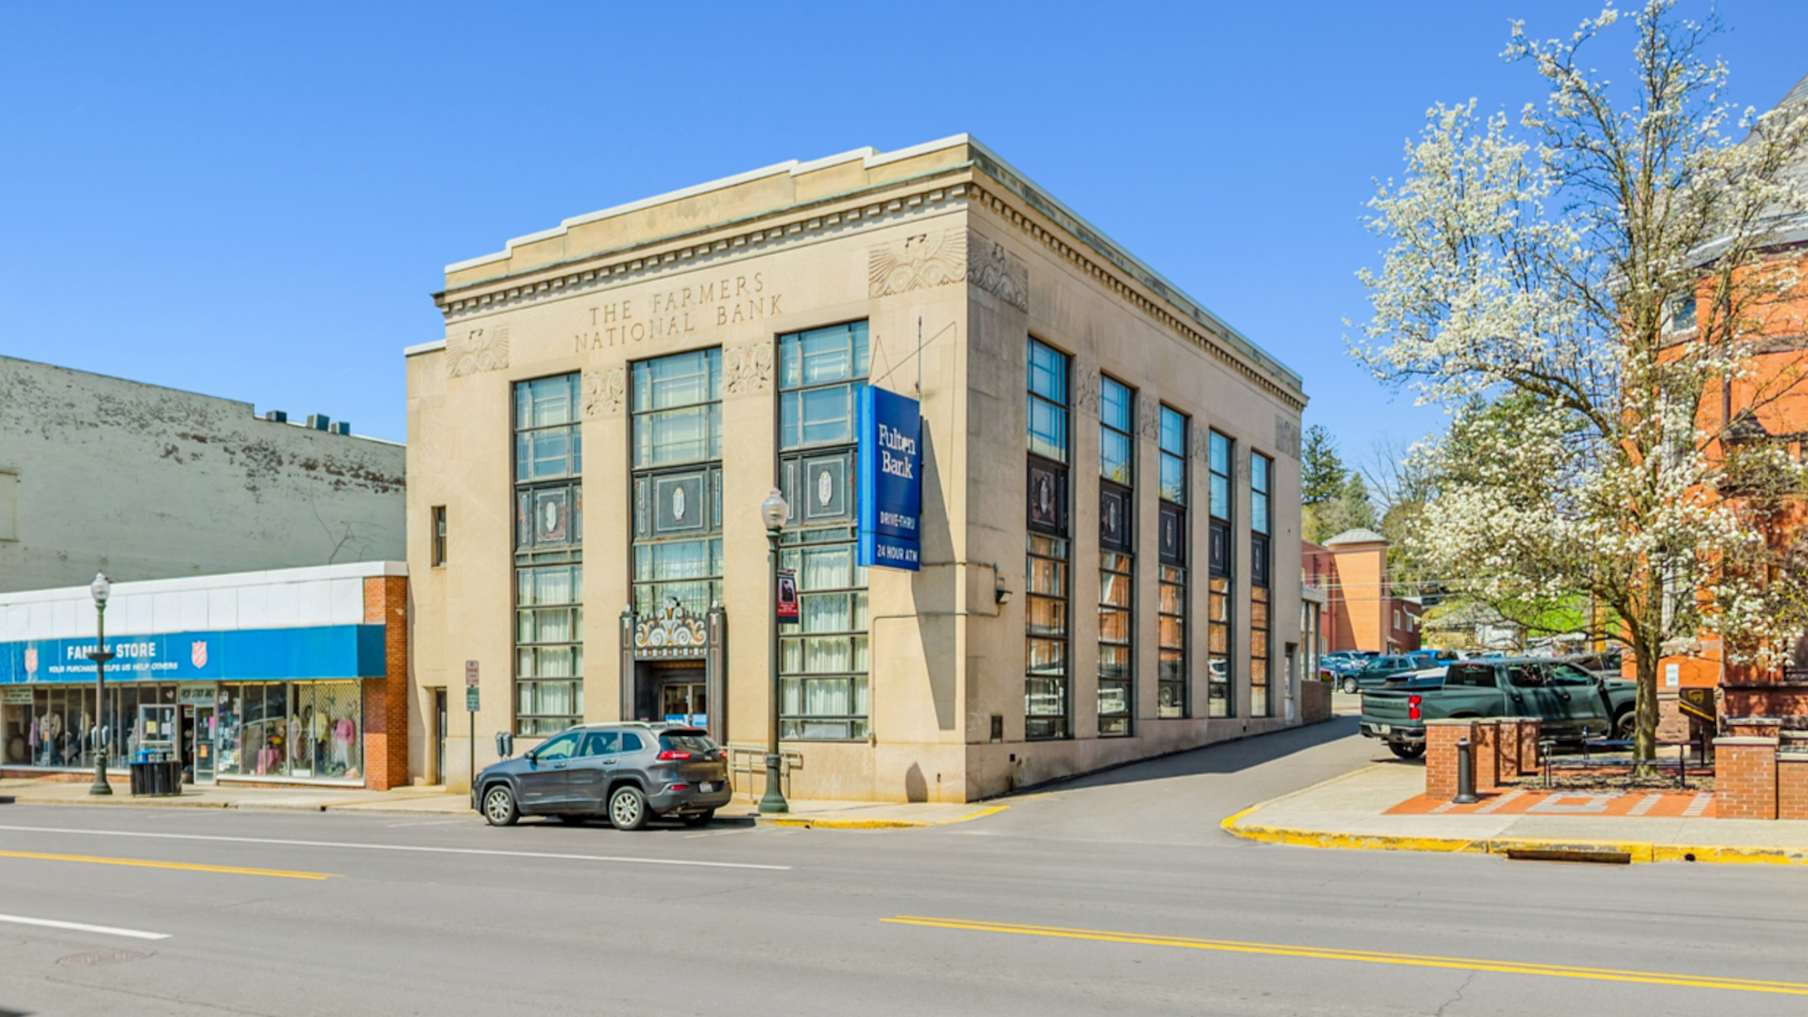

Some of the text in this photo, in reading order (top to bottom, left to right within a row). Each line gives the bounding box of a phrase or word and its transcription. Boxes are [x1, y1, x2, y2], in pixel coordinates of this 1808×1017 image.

[589, 272, 764, 326] THE FARMERS
[575, 294, 784, 353] NATIONAL BANK
[879, 423, 916, 455] Fulton
[882, 450, 913, 479] Bank
[880, 511, 915, 530] DRIVE-THRU
[877, 544, 918, 562] 24 HOUR ATM
[67, 642, 156, 660] FAMIY STORE
